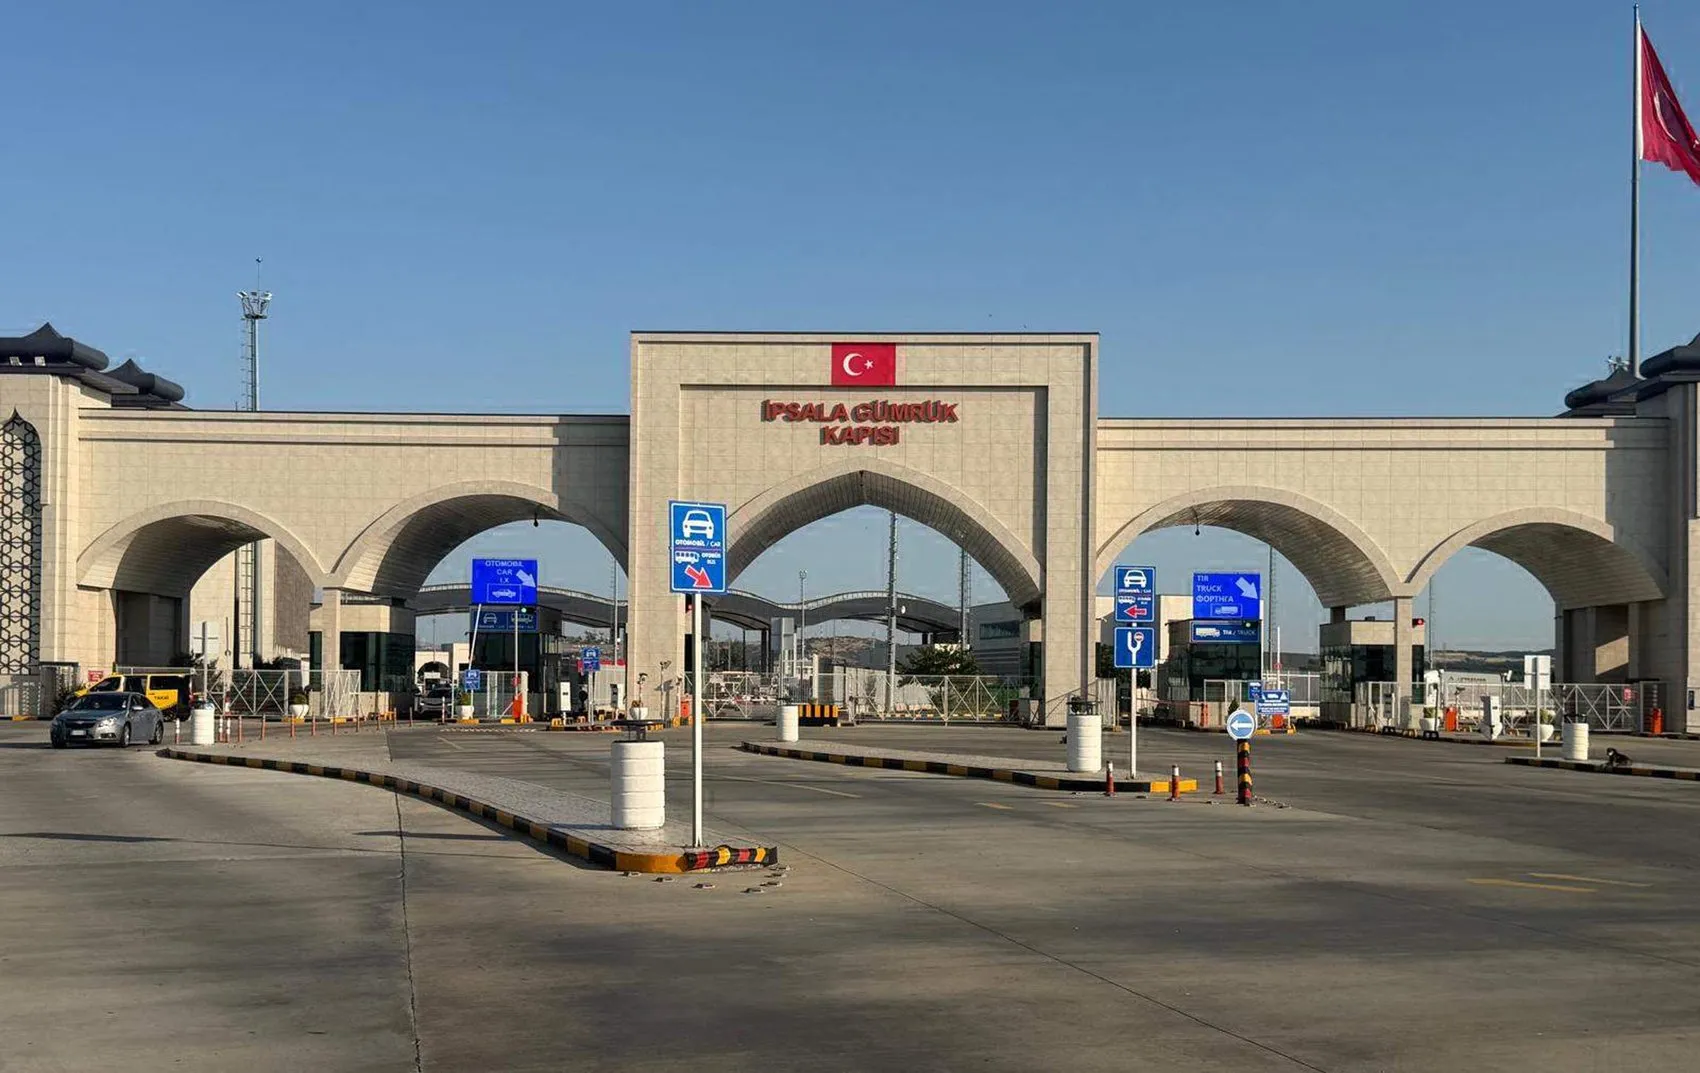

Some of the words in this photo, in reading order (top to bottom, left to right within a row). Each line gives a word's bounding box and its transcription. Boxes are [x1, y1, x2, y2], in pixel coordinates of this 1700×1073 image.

[760, 399, 849, 422] İPSALA
[851, 399, 959, 422] GÜMRÜK
[820, 426, 899, 445] KAPISI
[1196, 585, 1222, 593] TRUCK
